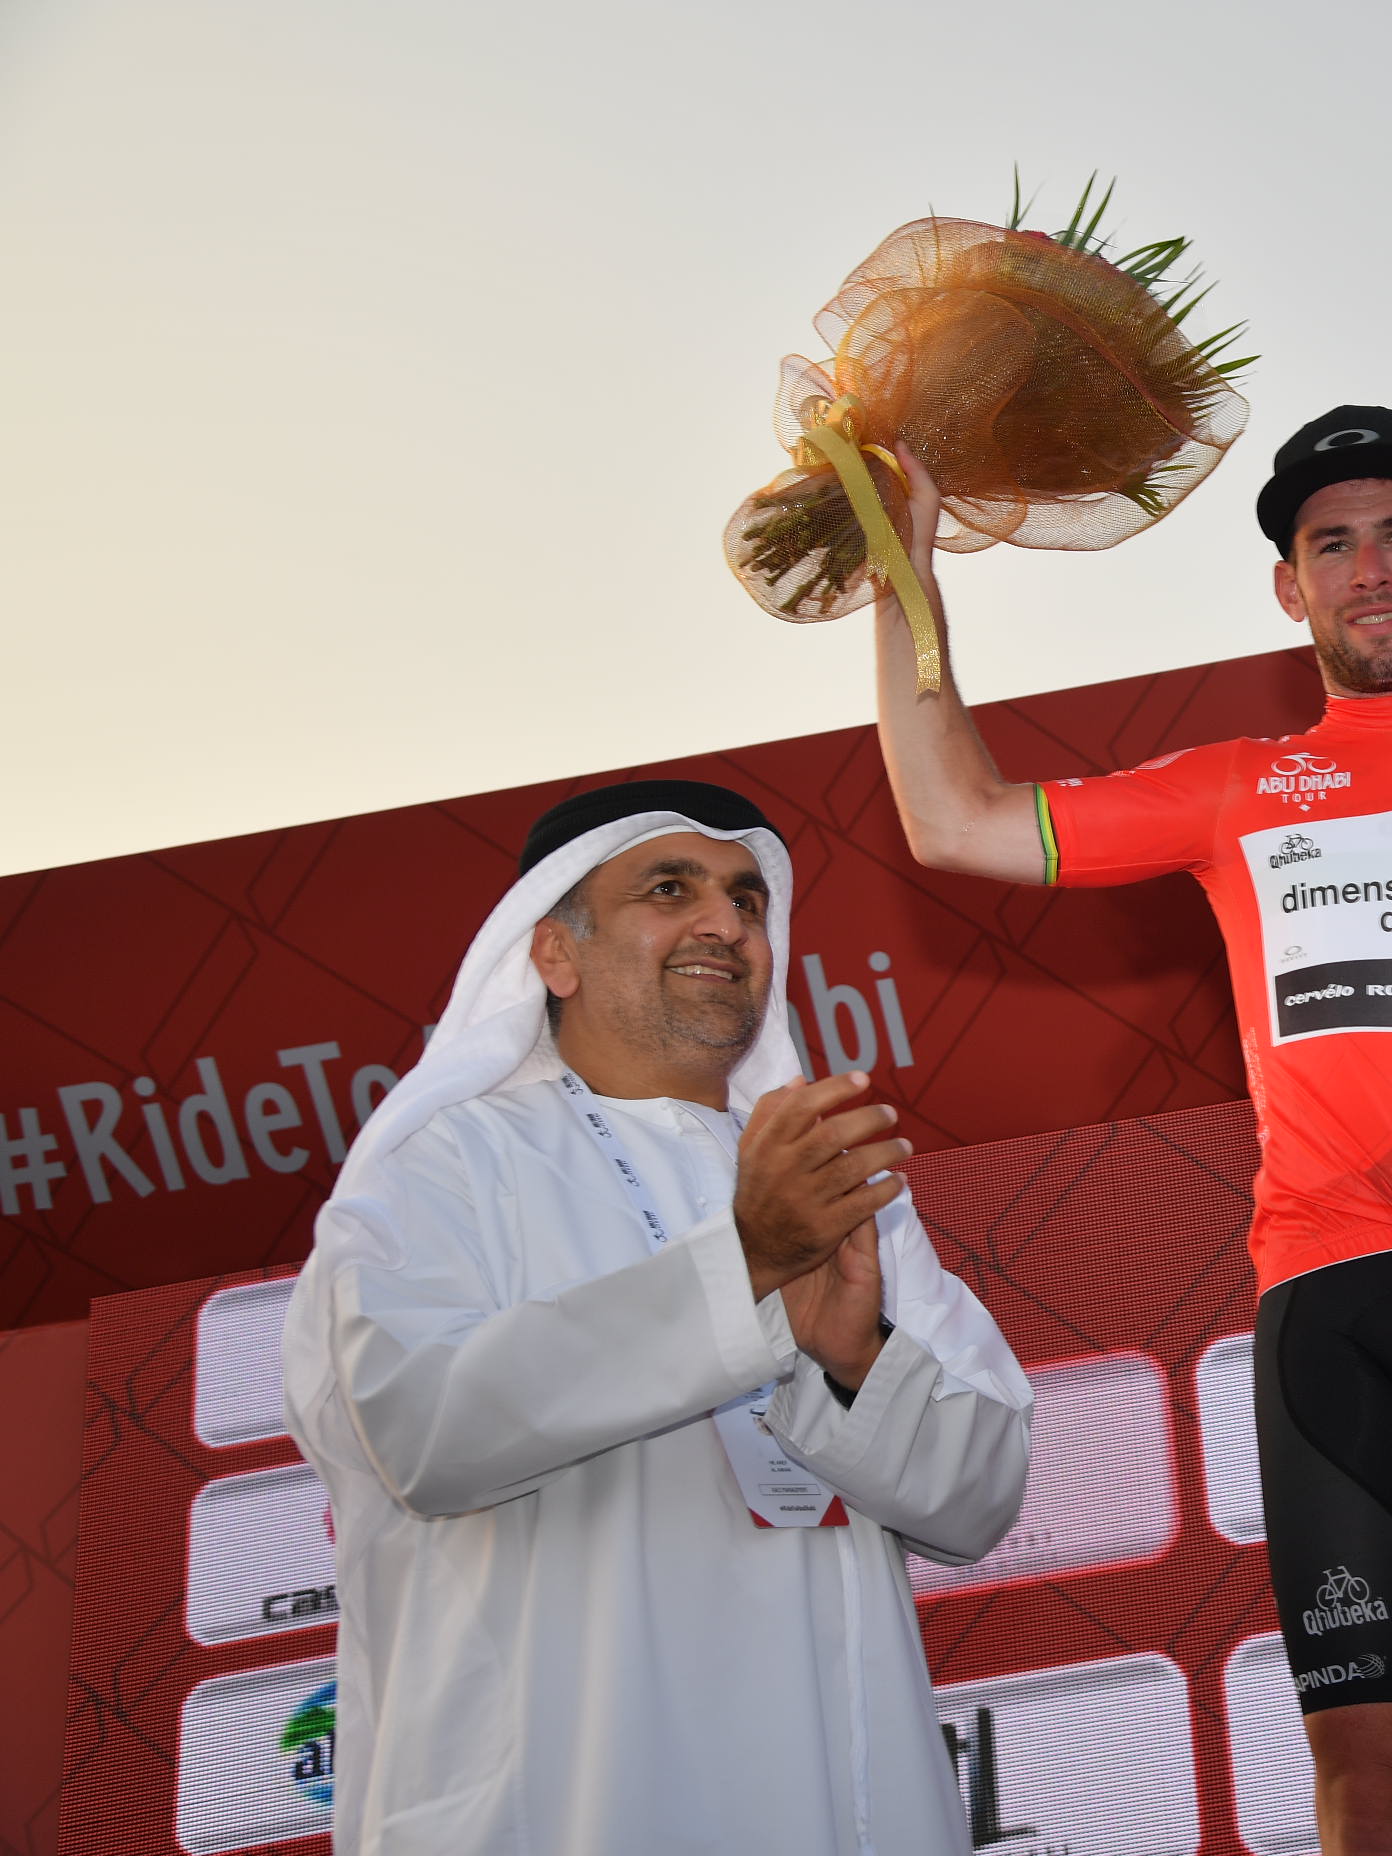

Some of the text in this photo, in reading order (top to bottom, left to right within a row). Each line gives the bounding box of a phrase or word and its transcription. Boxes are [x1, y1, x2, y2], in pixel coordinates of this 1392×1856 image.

[1256, 771, 1351, 794] ABU DHABI
[1281, 791, 1327, 804] TOUR
[1269, 847, 1322, 869] Qhubeka
[1284, 983, 1355, 1007] cervélo
[1302, 1599, 1390, 1636] Qhubeka
